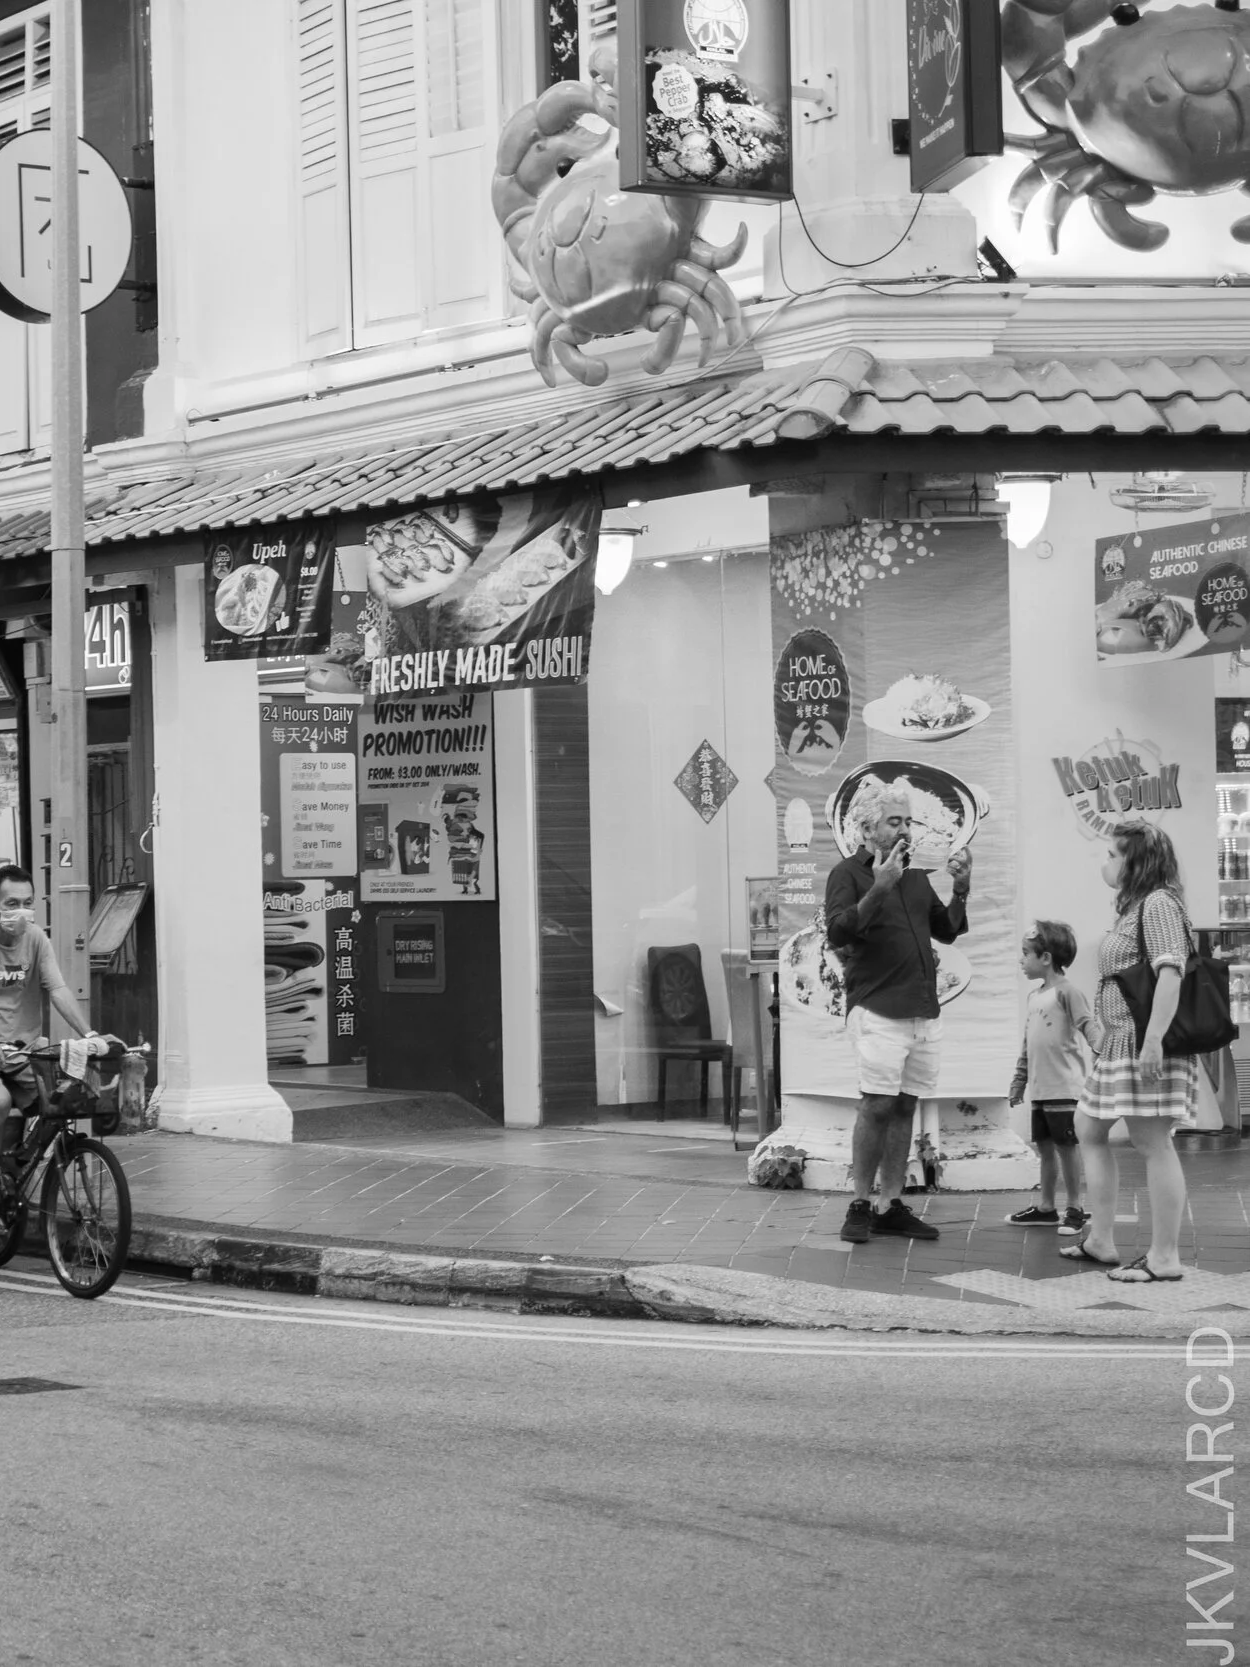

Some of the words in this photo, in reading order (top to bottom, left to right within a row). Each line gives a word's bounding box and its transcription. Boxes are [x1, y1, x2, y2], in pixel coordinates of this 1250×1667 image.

[663, 75, 683, 87] Best
[659, 84, 690, 98] Pepper
[668, 94, 688, 107] Crab
[252, 540, 287, 564] Upeh
[1150, 543, 1205, 563] AUTHENTIC
[1207, 536, 1248, 553] CHINESE
[1149, 561, 1198, 580] SEAFOOD
[1207, 576, 1237, 591] HOME
[1201, 588, 1247, 606] SEAFOOD
[370, 649, 450, 696] FRESHLY
[454, 643, 517, 686] MADE
[525, 636, 583, 680] SUSHI
[789, 654, 827, 677] HOME
[781, 678, 842, 702] SEAFOOD
[262, 706, 278, 721] 24
[283, 706, 319, 722] Hours
[323, 706, 354, 724] Daily
[374, 701, 416, 725] WISH
[421, 694, 475, 722] WASH
[271, 726, 349, 744] 每天24小时
[363, 724, 487, 757] PROMOTION!!!
[320, 761, 329, 770] to
[331, 762, 347, 770] use
[367, 767, 395, 780] FROM:
[398, 766, 423, 780] $3.00
[425, 763, 481, 779] ONLY/WASH.
[320, 802, 350, 813] Money
[321, 839, 342, 849] Time
[60, 843, 72, 867] 2
[263, 892, 291, 911] Anti
[294, 890, 354, 913] Bacterial
[395, 940, 409, 951] DRY
[411, 940, 433, 951] RISING
[396, 953, 413, 963] MAIN
[414, 952, 434, 963] INLET
[334, 927, 354, 1036] 高温杀菌
